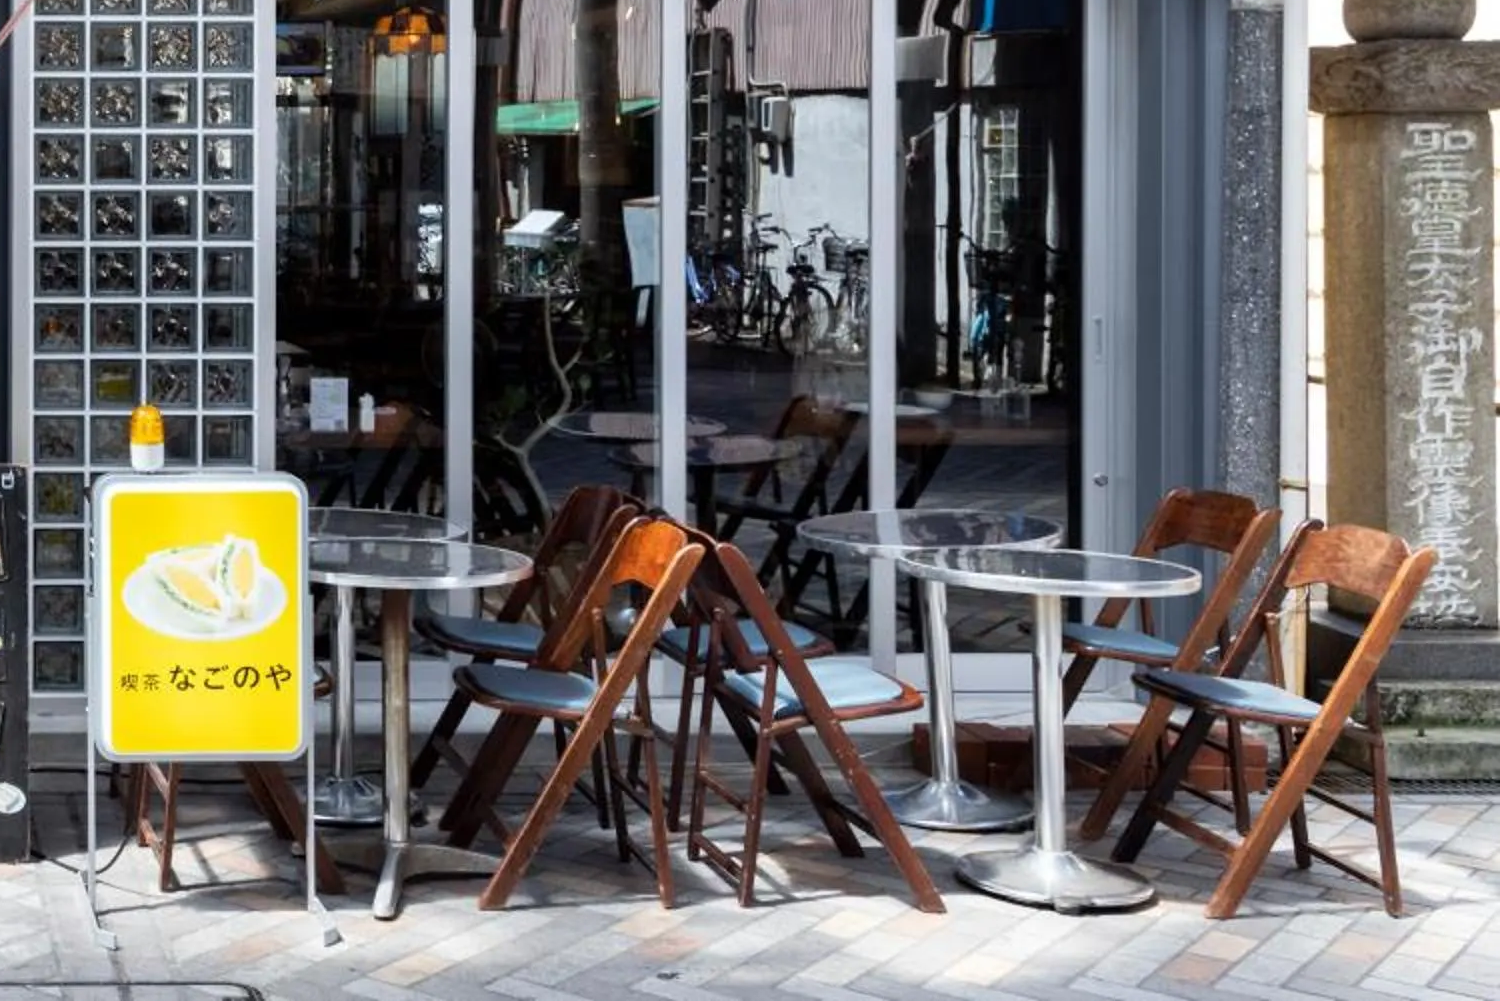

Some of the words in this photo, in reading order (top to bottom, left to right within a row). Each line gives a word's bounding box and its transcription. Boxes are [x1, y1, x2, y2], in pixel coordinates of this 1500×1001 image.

[119, 673, 160, 692] 喫茶
[169, 663, 293, 692] なごのや
